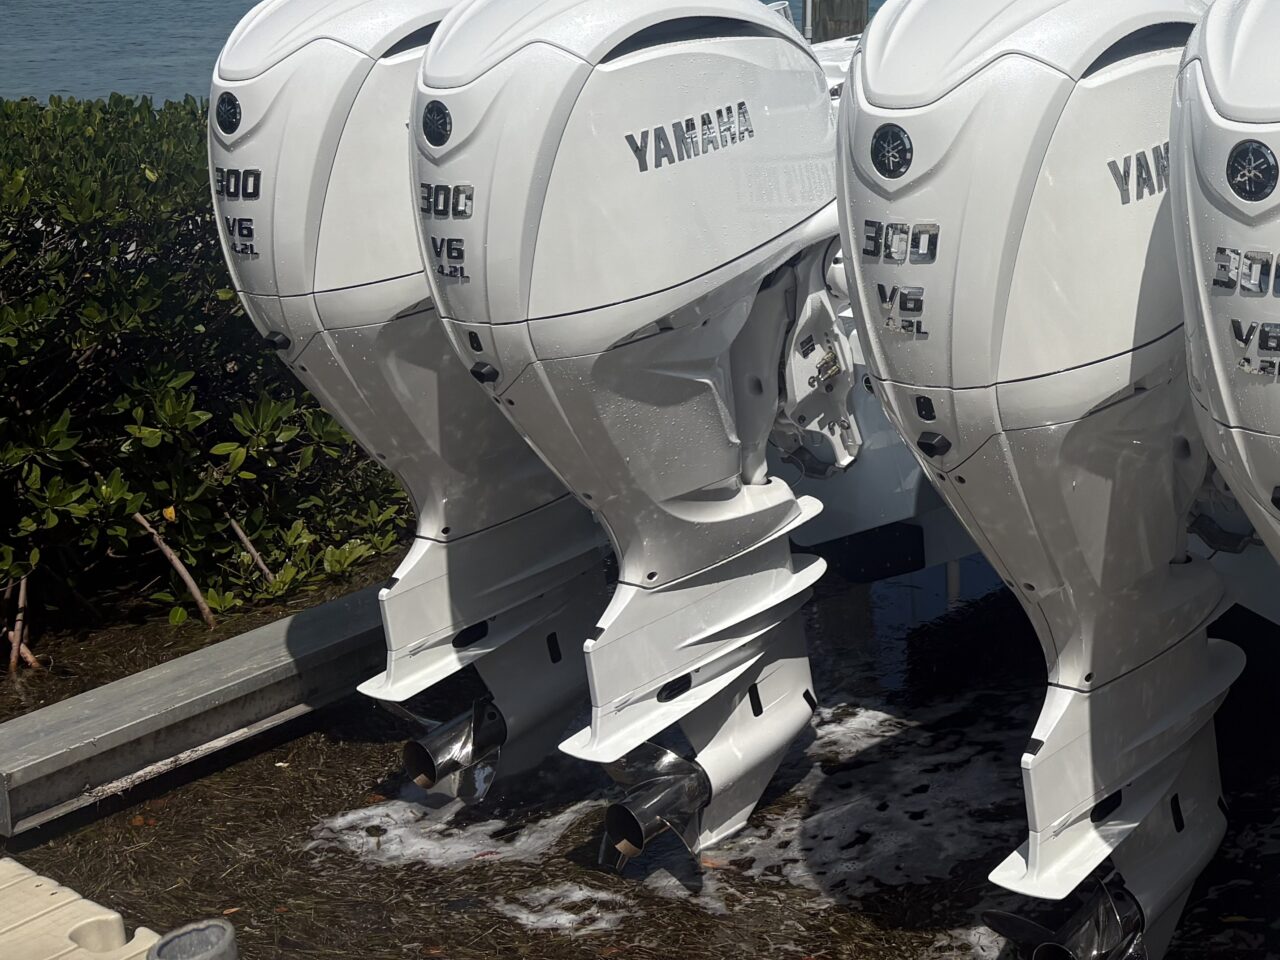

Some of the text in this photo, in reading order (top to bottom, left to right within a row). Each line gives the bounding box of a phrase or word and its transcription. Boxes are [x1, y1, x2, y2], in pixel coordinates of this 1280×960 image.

[625, 101, 755, 173] YAMAHA
[215, 167, 262, 200] 300
[1106, 141, 1170, 205] YAM
[421, 183, 475, 219] 300
[224, 216, 254, 240] V6
[863, 219, 940, 264] 300
[431, 236, 465, 264] V6
[877, 283, 924, 317] V6
